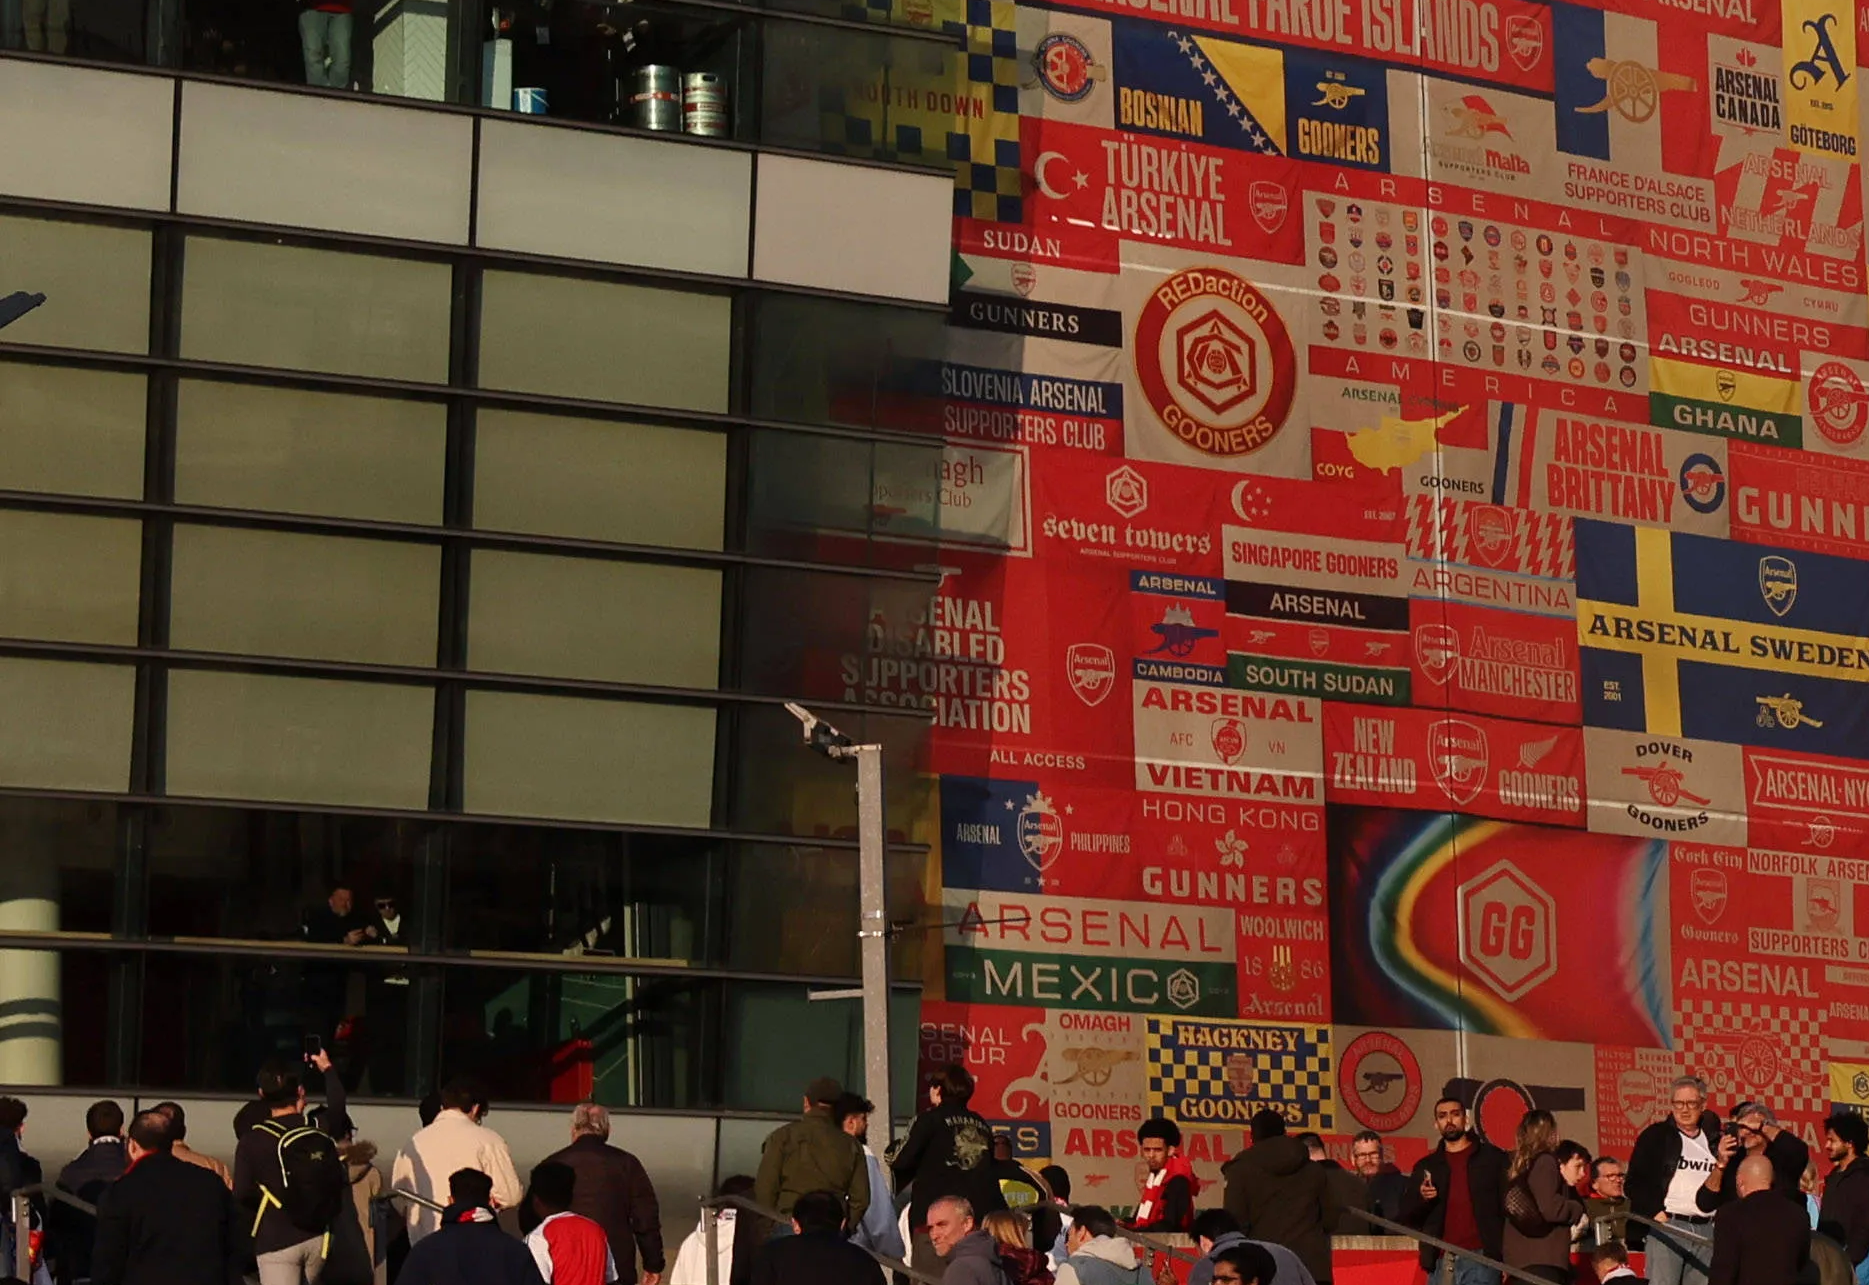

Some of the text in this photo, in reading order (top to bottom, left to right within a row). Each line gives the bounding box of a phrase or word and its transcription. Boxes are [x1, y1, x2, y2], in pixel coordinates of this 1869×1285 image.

[1715, 64, 1779, 105] ARSENAL
[925, 90, 985, 120] DOWN
[1715, 95, 1782, 132] CANADA
[1119, 85, 1204, 138] BOSNIAN
[1297, 117, 1380, 166] GOONERS
[1789, 122, 1856, 157] GÖTEBORG
[1101, 134, 1226, 202] TÜRKİYE
[1568, 163, 1706, 203] FRANCE D'ALSACE
[1743, 150, 1833, 191] ARSENAL
[1101, 186, 1233, 247] ARSENAL
[1564, 182, 1711, 223] SUPPORTERS CLUB
[983, 229, 1062, 259] SUDAN
[1720, 203, 1863, 250] NETHERLANDS
[1649, 230, 1858, 289] NORTH WALES
[1157, 271, 1270, 324] REDaction
[970, 302, 1081, 335] GUNNERS
[1688, 303, 1831, 349] GUNNERS
[1658, 331, 1792, 373] ARSENAL
[942, 369, 1106, 415] SLOVENIA ARSENAL
[1341, 386, 1402, 405] ARSENAL
[944, 404, 1106, 450] SUPPORTERS CLUB
[1161, 402, 1275, 454] GOONERS
[1673, 404, 1780, 439] GHANA
[1553, 417, 1669, 478] ARSENAL
[1316, 463, 1355, 479] COYG
[1420, 474, 1485, 496] GOONERS
[1546, 463, 1677, 523] BRITTANY
[1043, 519, 1212, 557] seven towers
[1231, 540, 1399, 580] SINGAPORE GOONERS
[1137, 574, 1217, 595] ARSENAL
[1412, 567, 1571, 609] ARGENTINA
[1269, 590, 1366, 621] ARSENAL
[1468, 625, 1566, 669] Arsenal
[1587, 614, 1740, 656] ARSENAL
[1135, 662, 1225, 685] CAMBODIA
[1246, 664, 1394, 697] SOUTH SUDAN
[1459, 658, 1576, 703] MANCHESTER
[1141, 686, 1313, 724] ARSENAL
[1169, 732, 1286, 755] AFC VN
[1353, 715, 1395, 756] NEW
[1635, 741, 1694, 764] DOVER
[990, 748, 1086, 772] ALL ACCESS
[1333, 753, 1417, 795] ZEALAND
[1146, 762, 1316, 800] VIETNAM
[1498, 768, 1580, 812] GOONERS
[1143, 798, 1320, 832] HONG KONG
[1626, 803, 1710, 833] GOONERS
[956, 822, 1131, 855] ARSENAL PHILIPPINES
[1748, 852, 1818, 876] NORFOLK
[1142, 867, 1323, 906] GUNNERS
[956, 902, 1223, 954] ARSENAL
[1240, 914, 1324, 943] WOOLWICH
[1479, 901, 1536, 960] GG
[1750, 930, 1850, 957] SUPPORTERS
[1244, 956, 1324, 980] 18 86
[1680, 958, 1819, 999] ARSENAL
[1059, 1013, 1132, 1034] OMAGH
[1243, 992, 1324, 1017] Arsenal
[1177, 1024, 1299, 1053] HACKNEY
[1053, 1101, 1142, 1122] GOONERS
[1179, 1097, 1304, 1124] GOONERS
